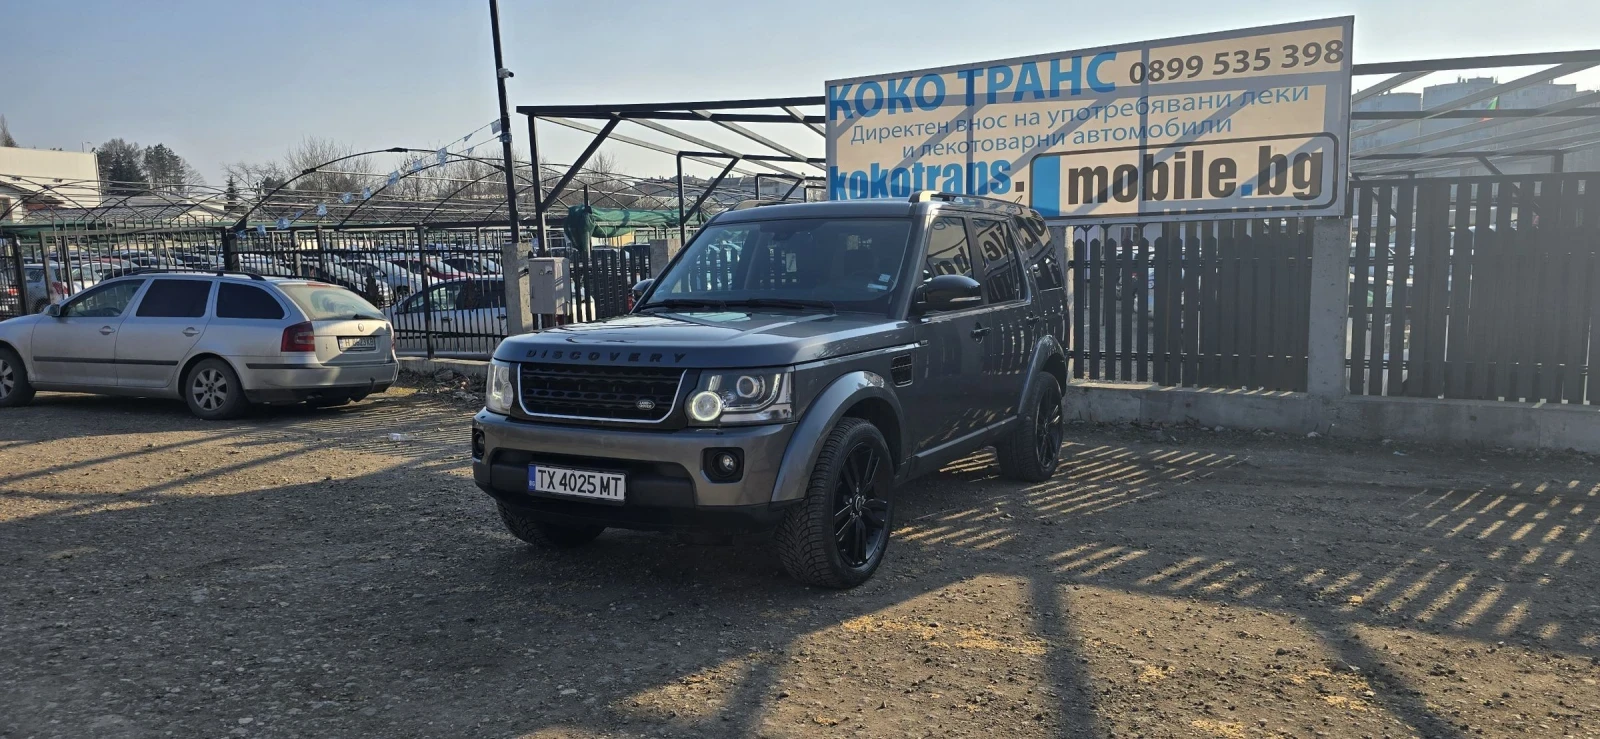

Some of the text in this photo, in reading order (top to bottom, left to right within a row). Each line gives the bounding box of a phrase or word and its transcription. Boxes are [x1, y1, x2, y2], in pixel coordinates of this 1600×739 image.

[1129, 39, 1344, 84] 0899 535 398
[829, 51, 1117, 120] КОКО ТРАНС
[850, 86, 1309, 145] Директен внос на употребявани леки
[902, 116, 1232, 159] и лекотоварни автомобили
[1067, 145, 1325, 205] mobile.bg
[525, 350, 687, 363] DISCOVERY
[537, 469, 556, 490] TX
[559, 472, 597, 494] 4025
[600, 476, 622, 497] MT
